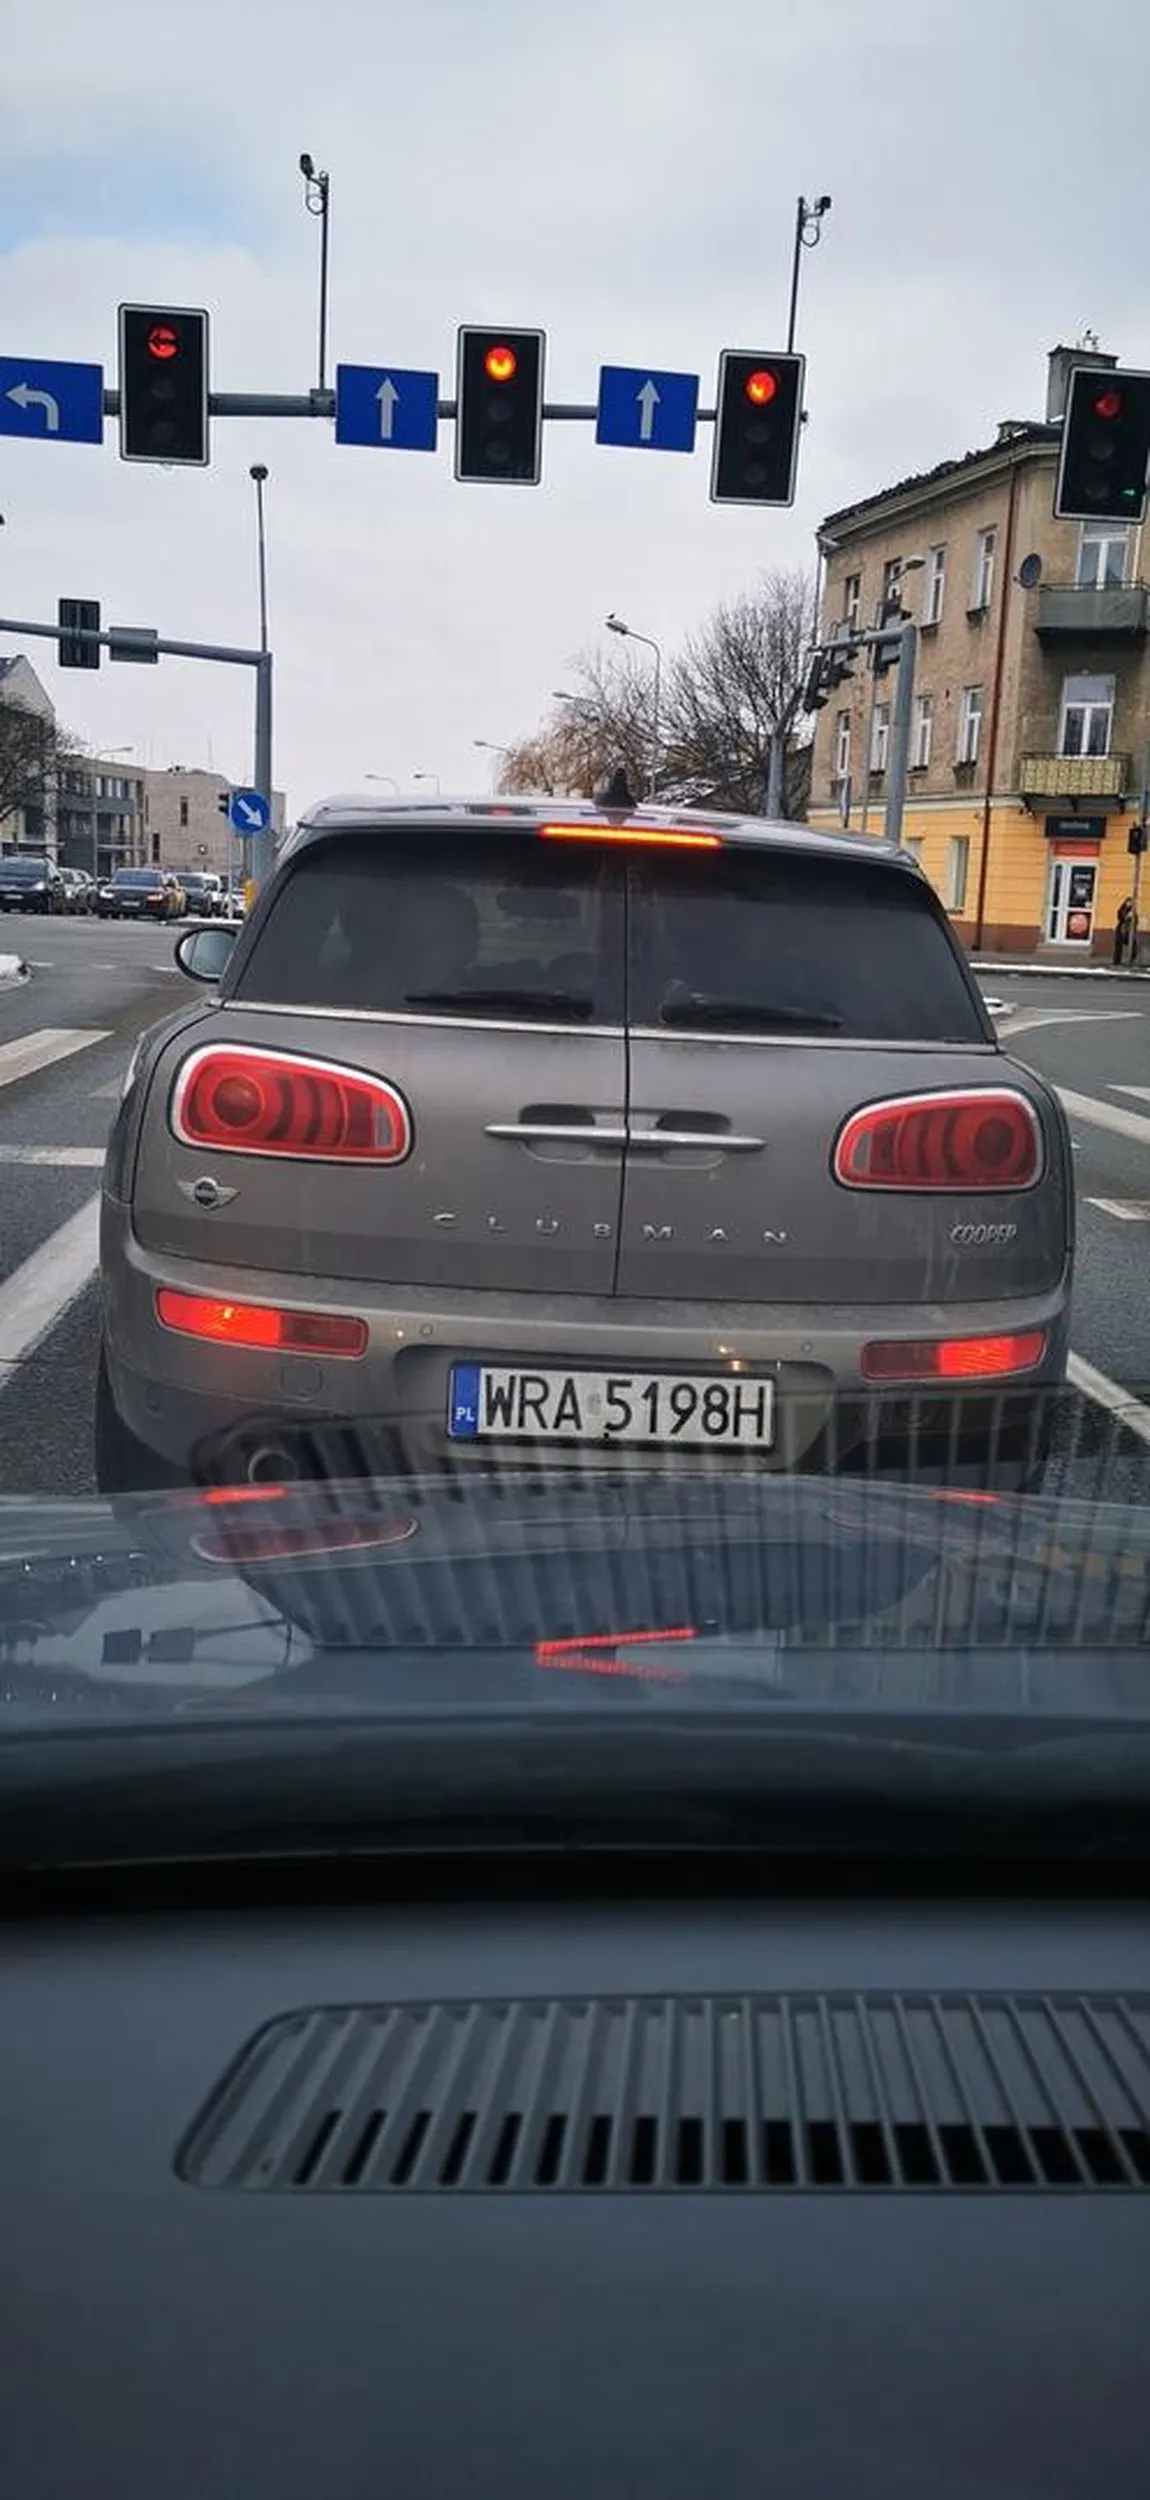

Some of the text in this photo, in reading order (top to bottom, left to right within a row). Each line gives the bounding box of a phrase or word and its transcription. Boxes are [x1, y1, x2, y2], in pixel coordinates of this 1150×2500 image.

[432, 1211, 787, 1243] CLUBMAN
[950, 1224, 1017, 1244] COOPER
[455, 1407, 475, 1422] PL
[485, 1374, 765, 1438] WRA 5198H
